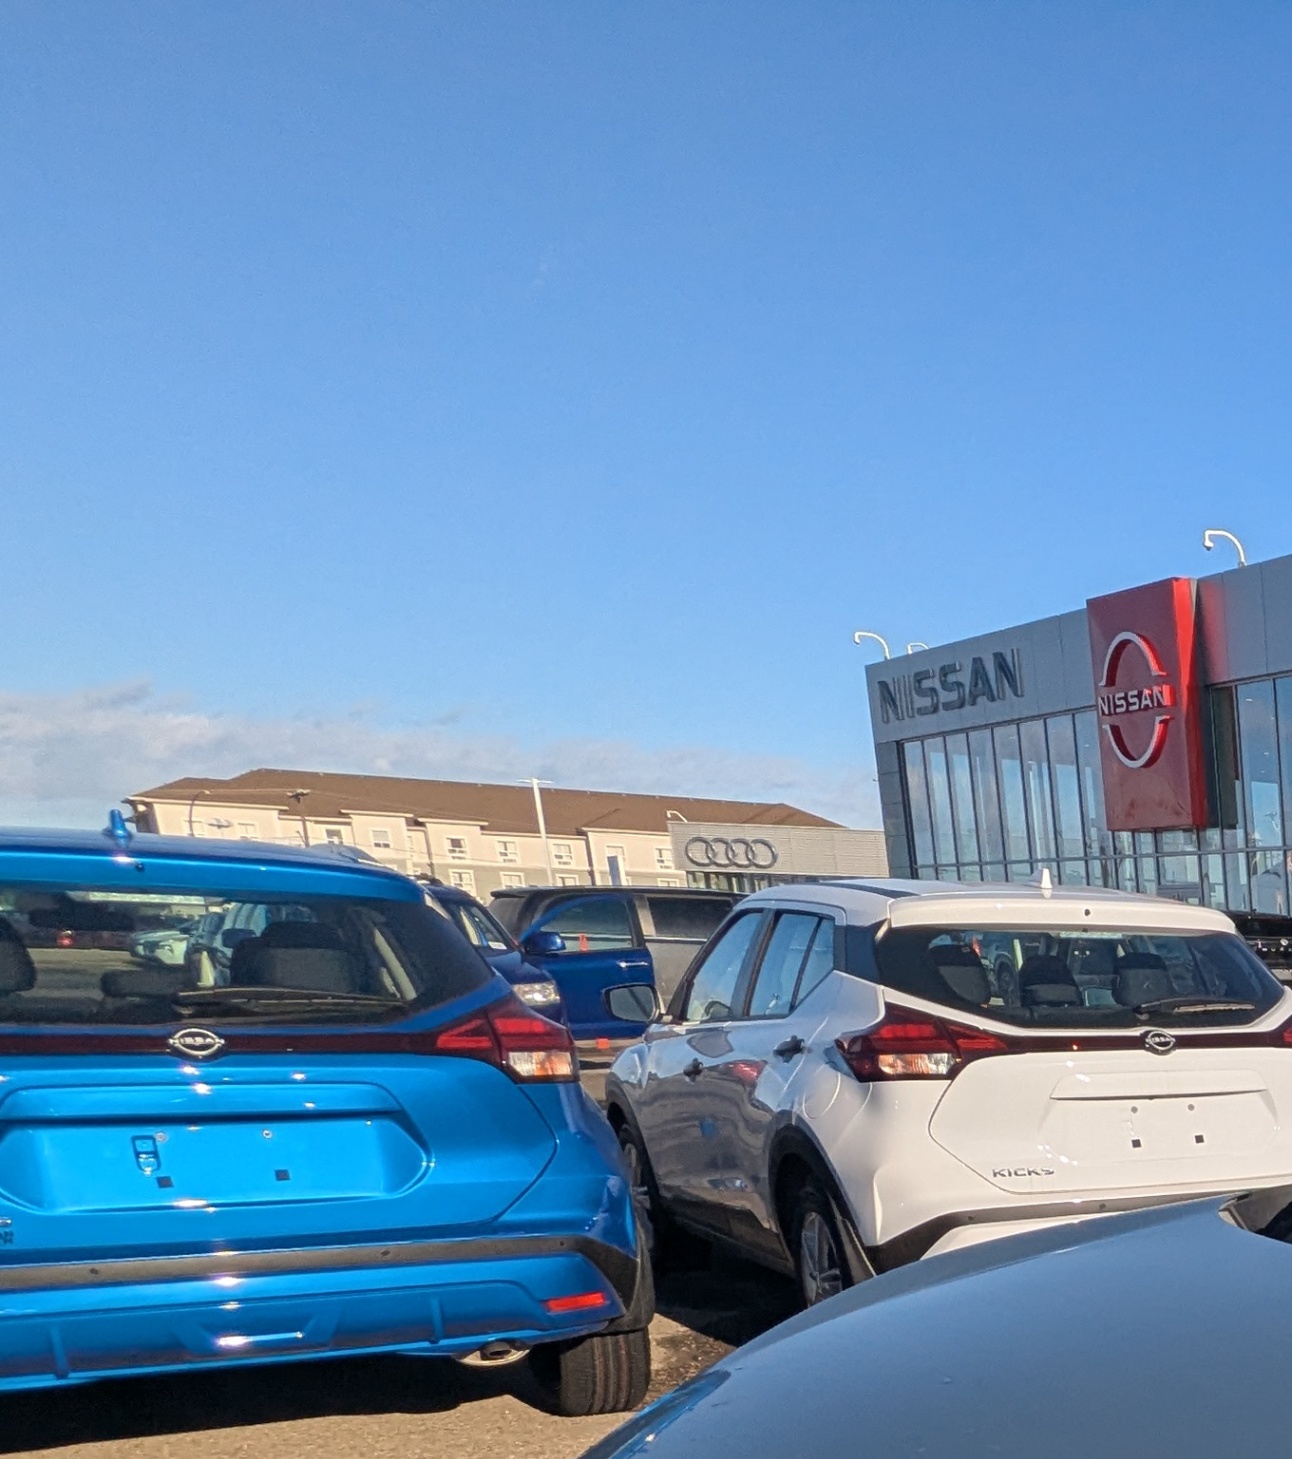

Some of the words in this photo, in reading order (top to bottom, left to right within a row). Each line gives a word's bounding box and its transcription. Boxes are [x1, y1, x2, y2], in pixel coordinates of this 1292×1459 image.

[877, 648, 1024, 724] NISSAN
[1098, 685, 1172, 716] NISSAN
[992, 1166, 1055, 1178] KICKS
